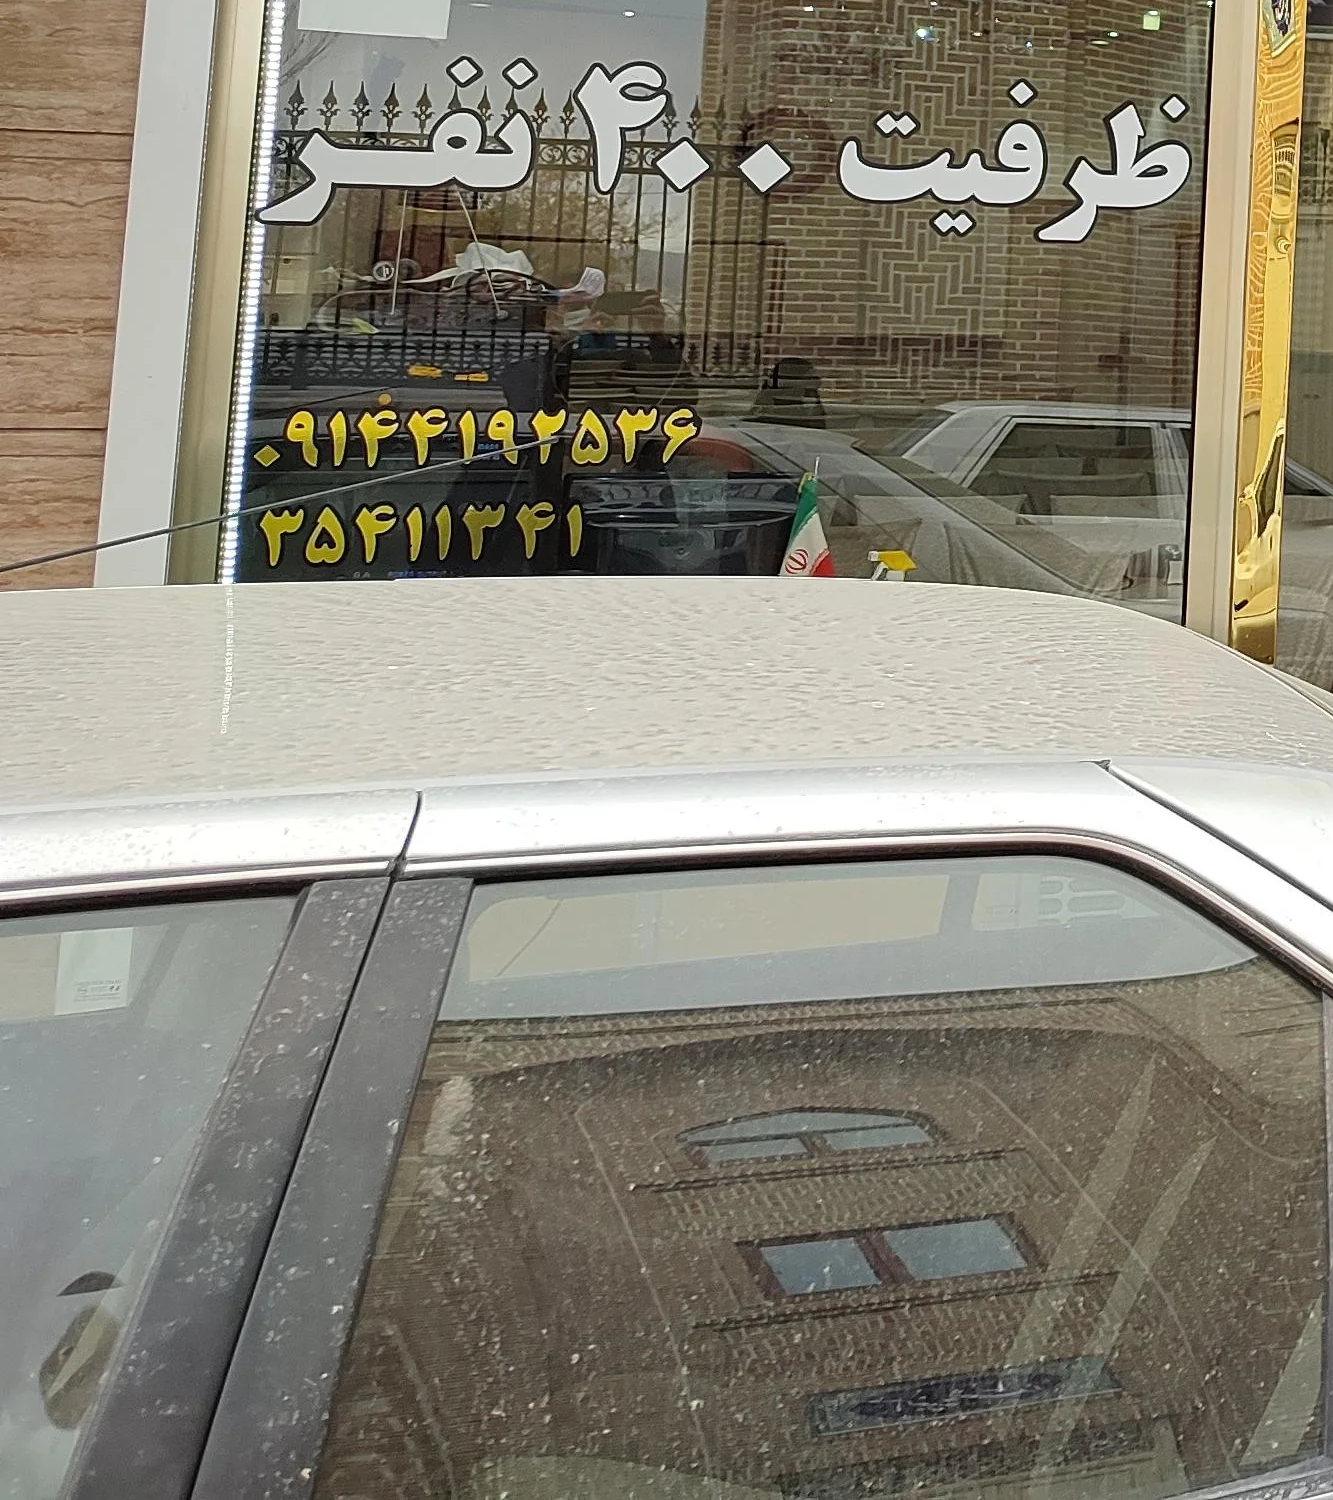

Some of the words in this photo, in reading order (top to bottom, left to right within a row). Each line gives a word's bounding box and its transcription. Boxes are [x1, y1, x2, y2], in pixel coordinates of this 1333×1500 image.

[255, 56, 538, 225] نفر
[576, 60, 793, 195] ۴۰۰
[837, 78, 1192, 242] ظرفیت
[253, 407, 701, 468] ۰۹۱۴۴۱۹۲۵۳۶
[259, 502, 584, 569] ۳۵۴۱۱۳۴۱
